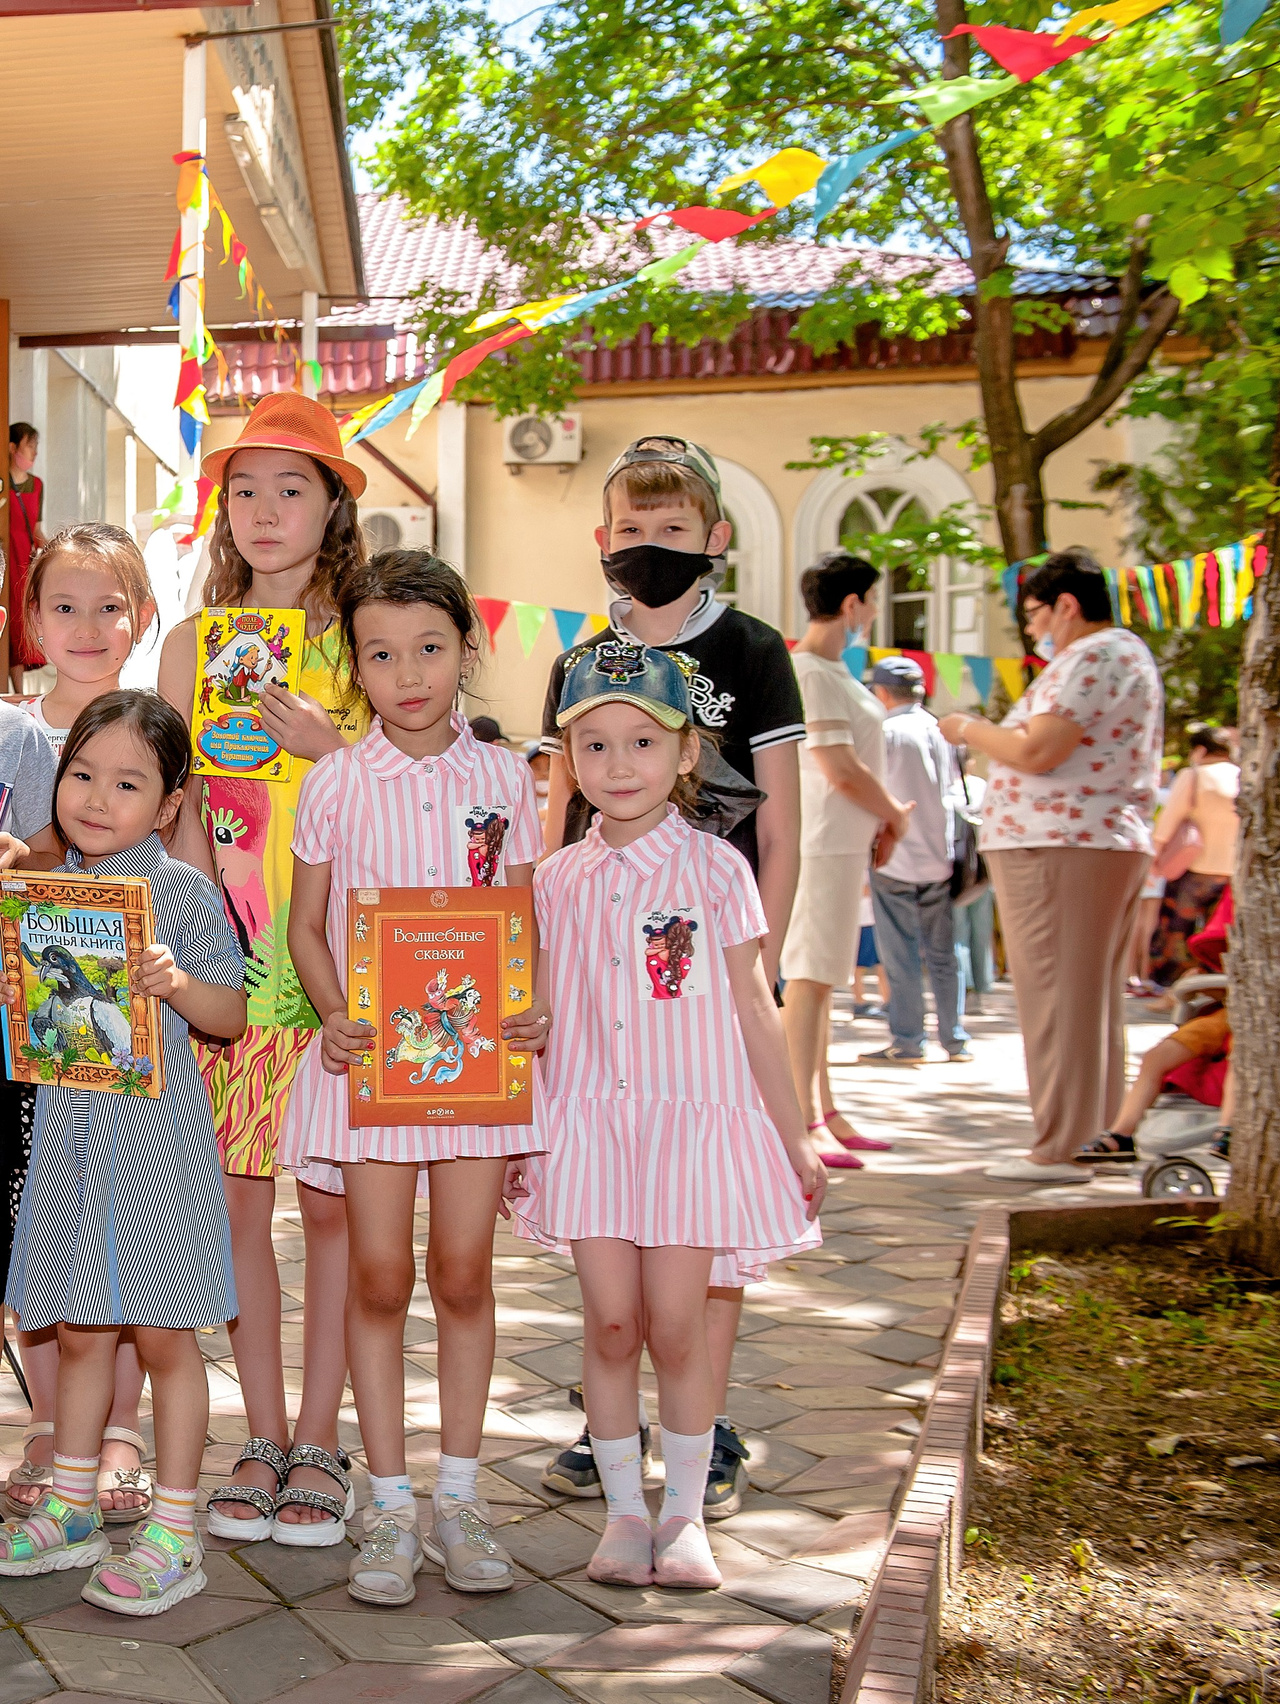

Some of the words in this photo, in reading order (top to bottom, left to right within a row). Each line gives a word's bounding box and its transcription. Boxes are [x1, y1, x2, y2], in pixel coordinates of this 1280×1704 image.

[26, 912, 124, 938] БОЛЬШАЯ
[393, 927, 486, 943] Волшебные
[414, 949, 465, 961] сказки
